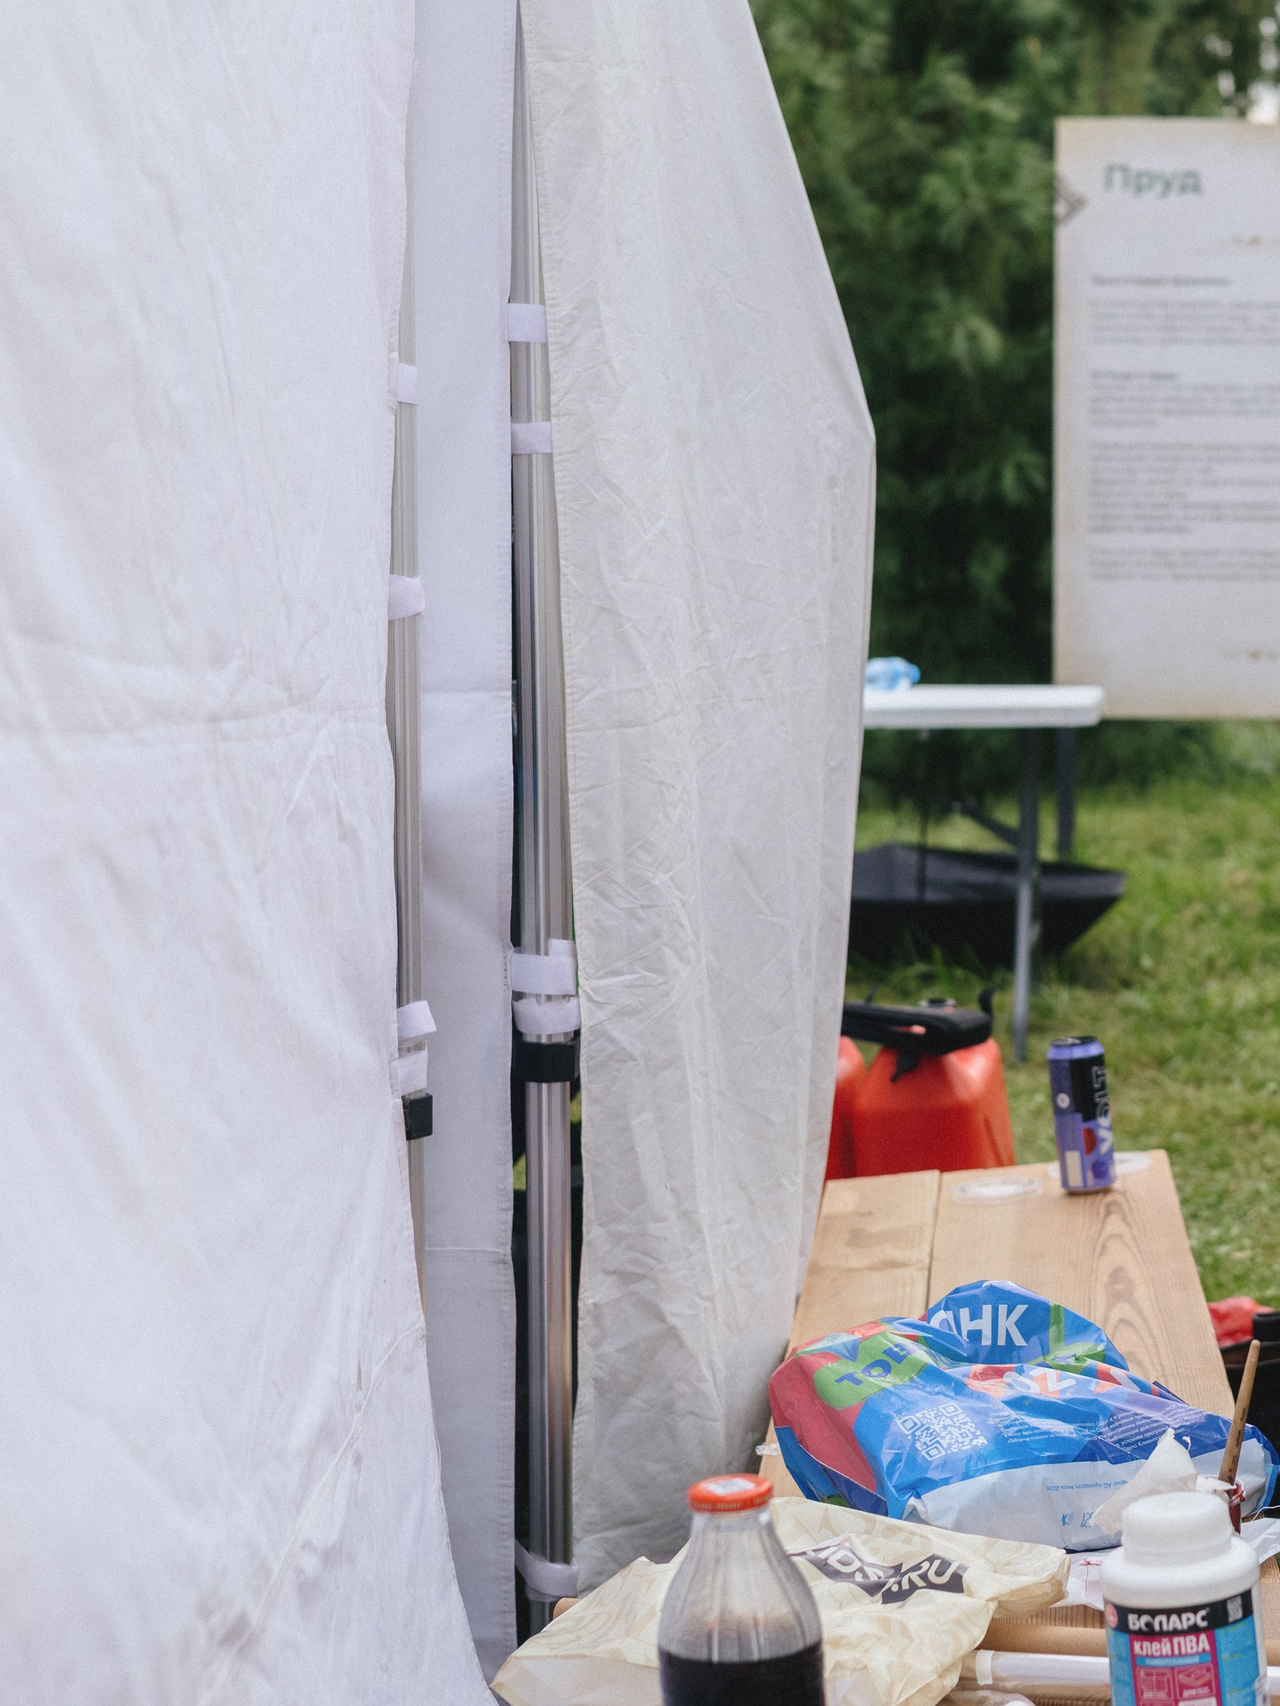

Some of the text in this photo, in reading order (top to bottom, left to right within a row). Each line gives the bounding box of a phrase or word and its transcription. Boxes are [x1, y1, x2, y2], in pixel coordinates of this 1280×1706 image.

[1104, 163, 1203, 198] Пруд
[1127, 1609, 1208, 1633] БОЛАРС
[1172, 1633, 1210, 1655] ПВА
